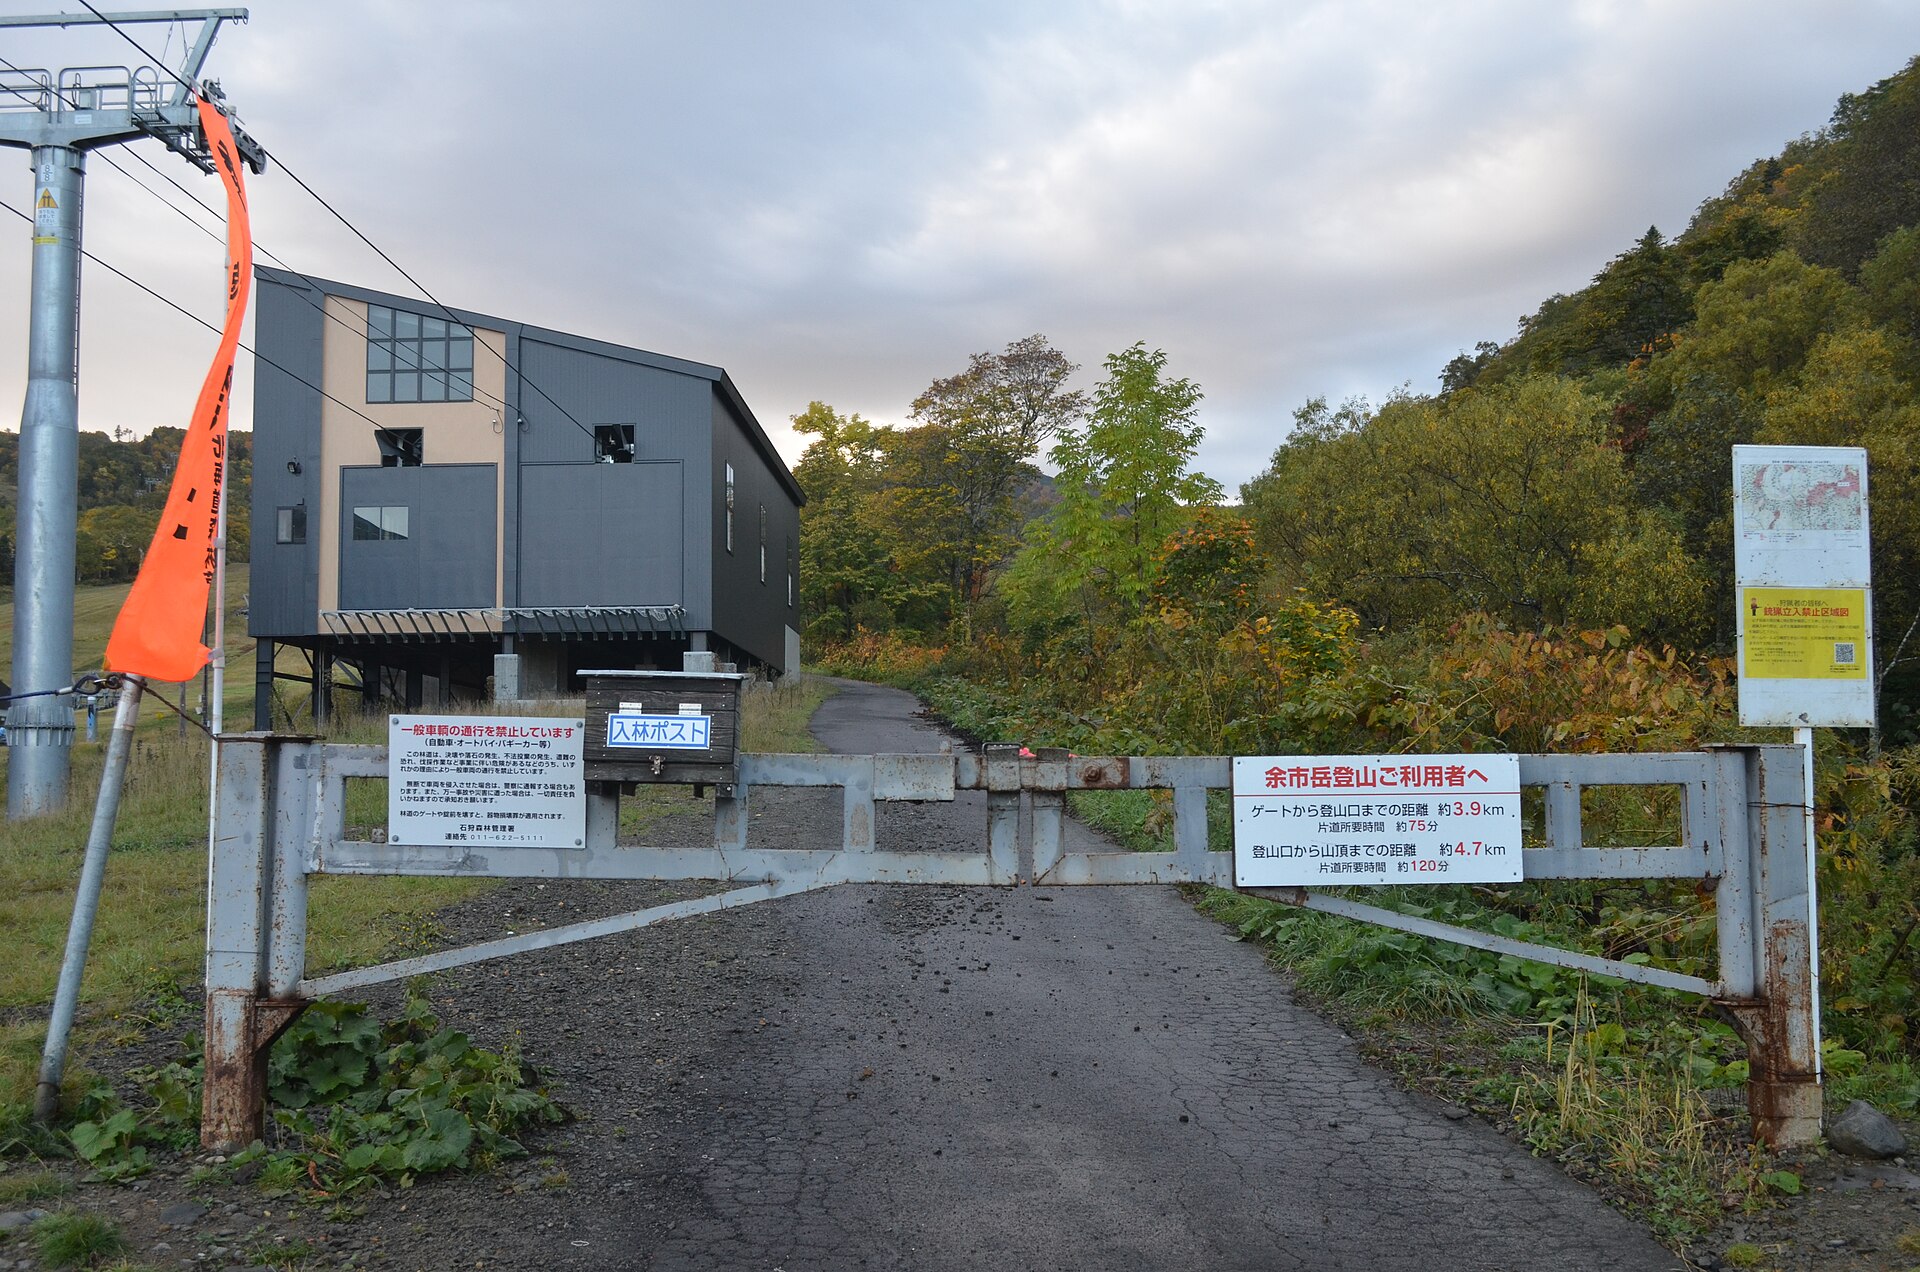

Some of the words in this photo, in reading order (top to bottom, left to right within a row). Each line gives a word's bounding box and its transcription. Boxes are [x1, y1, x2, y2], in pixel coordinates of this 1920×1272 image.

[1763, 607, 1849, 617] 銃猟立入禁止区域図
[613, 720, 704, 742] 入林ポスト
[1265, 765, 1489, 788] 余市岳登山ご利用者へ
[1251, 803, 1429, 818] ゲートから登山口までの距離
[459, 824, 516, 833] 石狩森林管理署
[1317, 821, 1385, 833] 片道所要時間
[1396, 820, 1439, 833] 約75分
[445, 833, 467, 841] 連絡先
[1252, 843, 1417, 859] 登山口から山頂までの距離
[1319, 861, 1387, 873] 片道所要時間
[1397, 860, 1449, 873] 約120分
